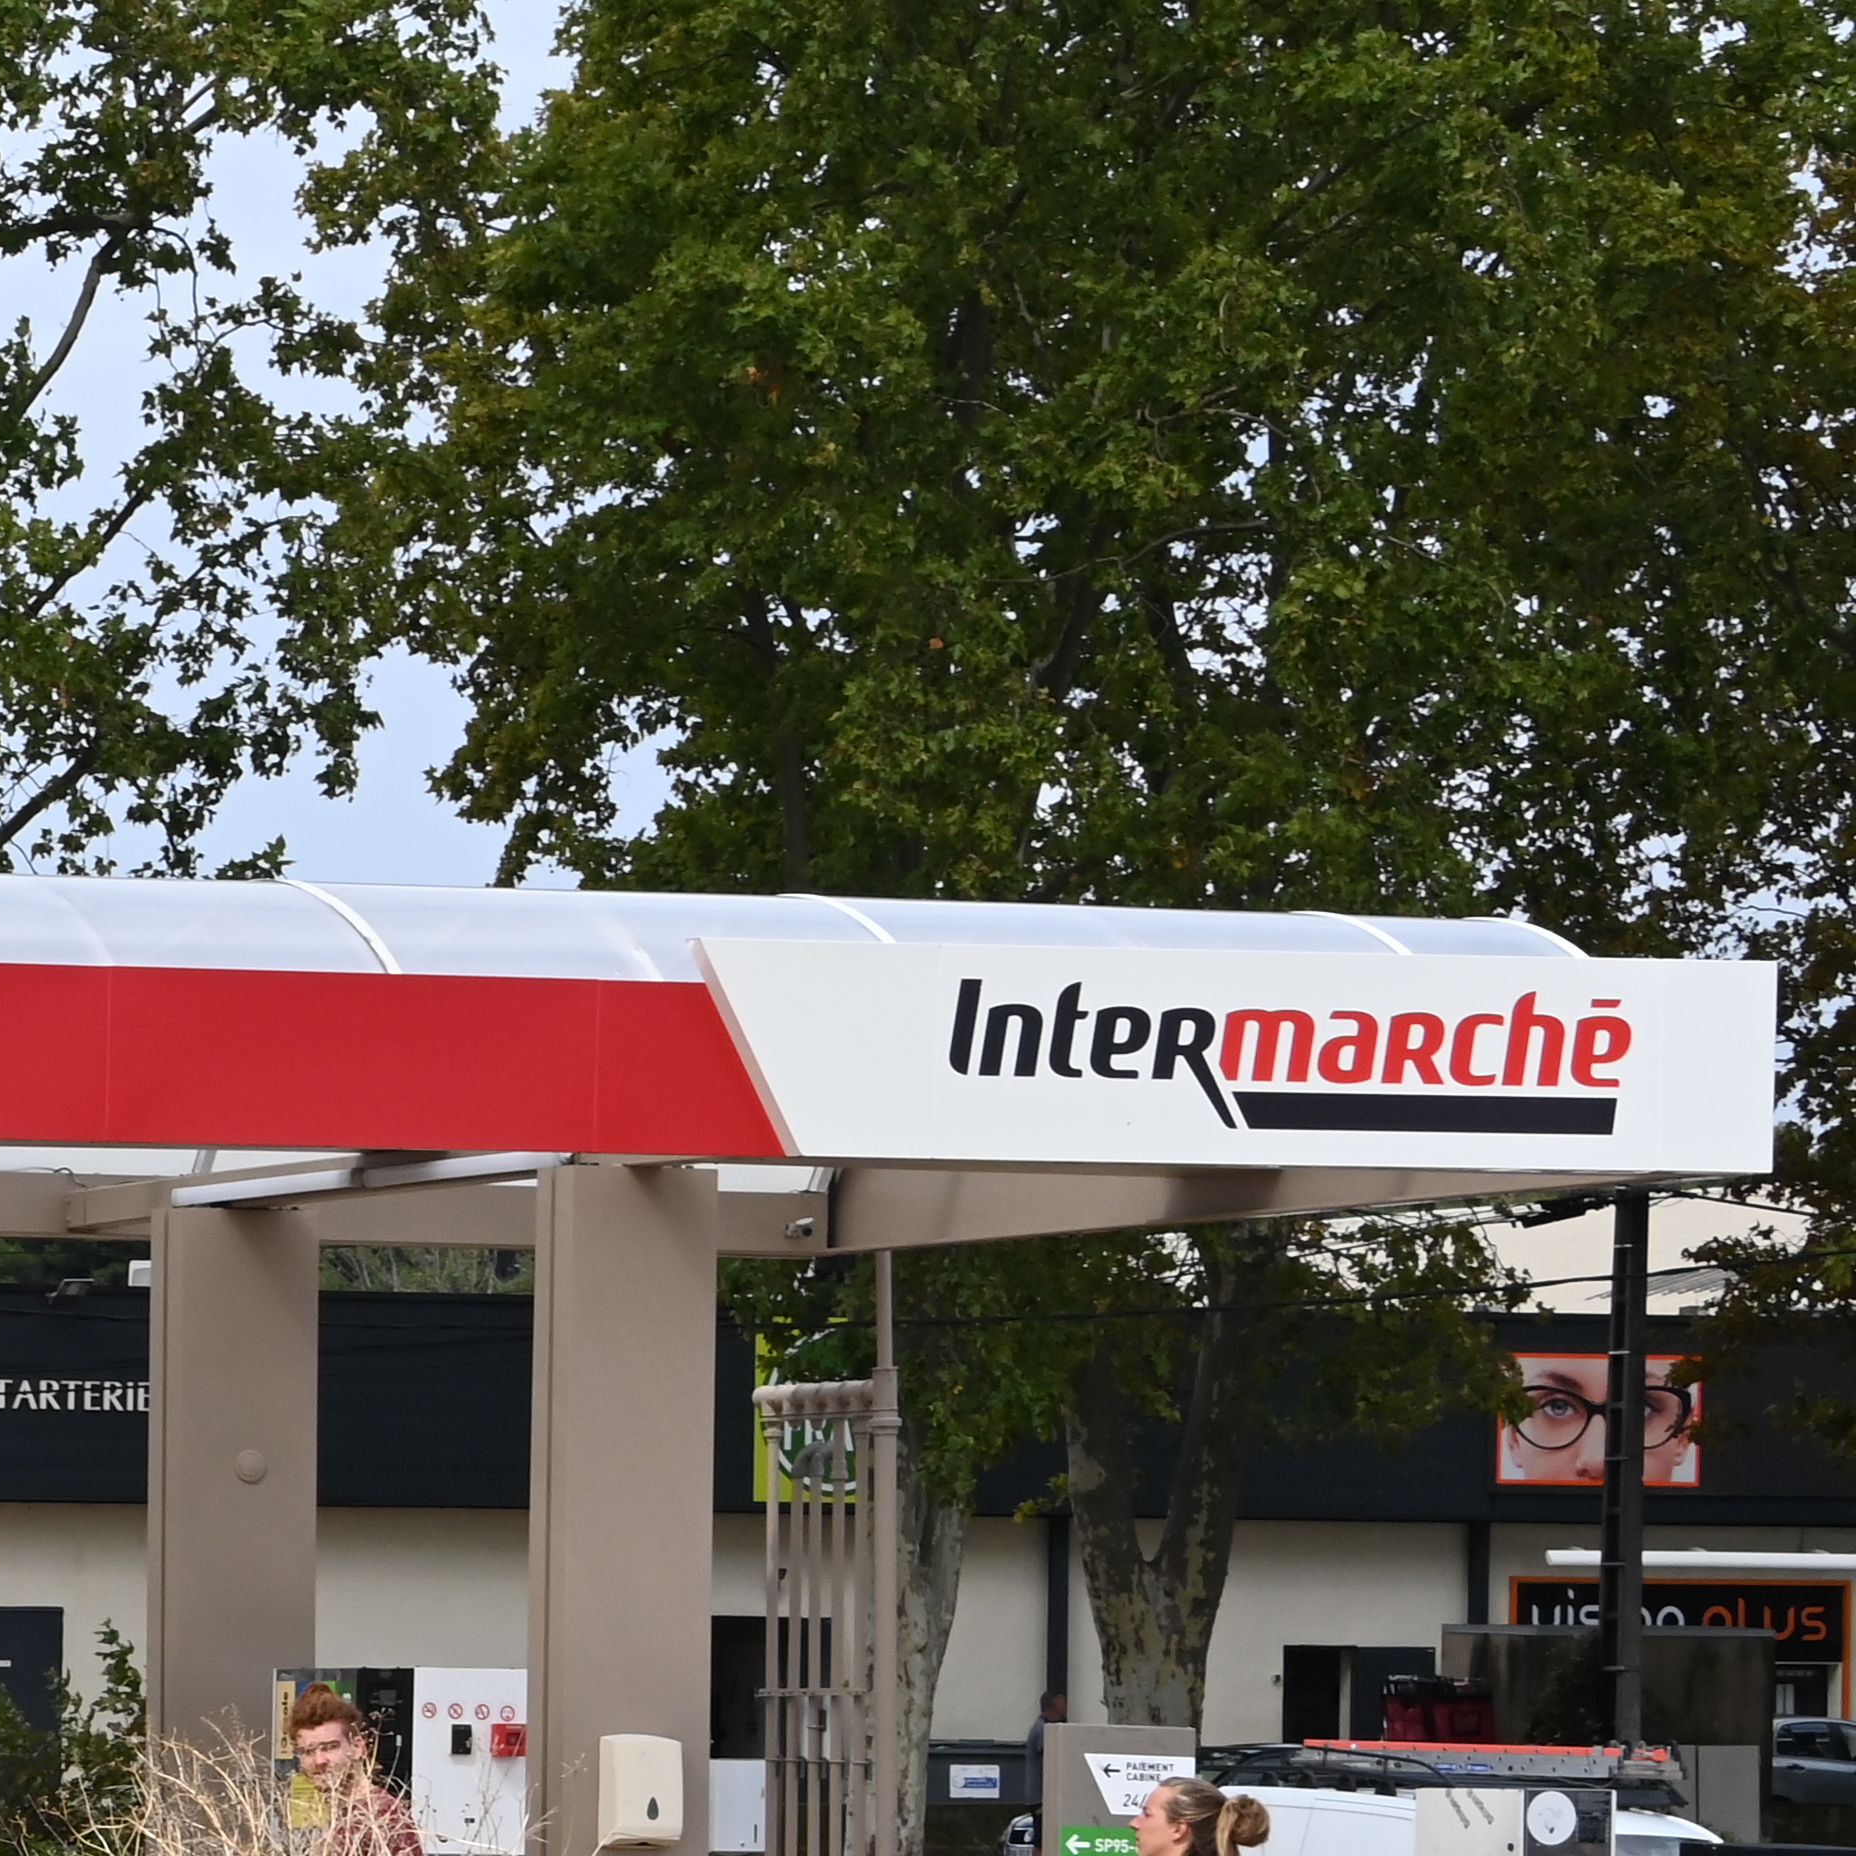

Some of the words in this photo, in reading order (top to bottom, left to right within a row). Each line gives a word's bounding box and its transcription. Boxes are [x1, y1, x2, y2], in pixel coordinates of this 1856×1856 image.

[1126, 1762, 1175, 1772] PAIEMENT
[1126, 1773, 1162, 1782] CABINE
[1094, 1838, 1139, 1854] SP95-
